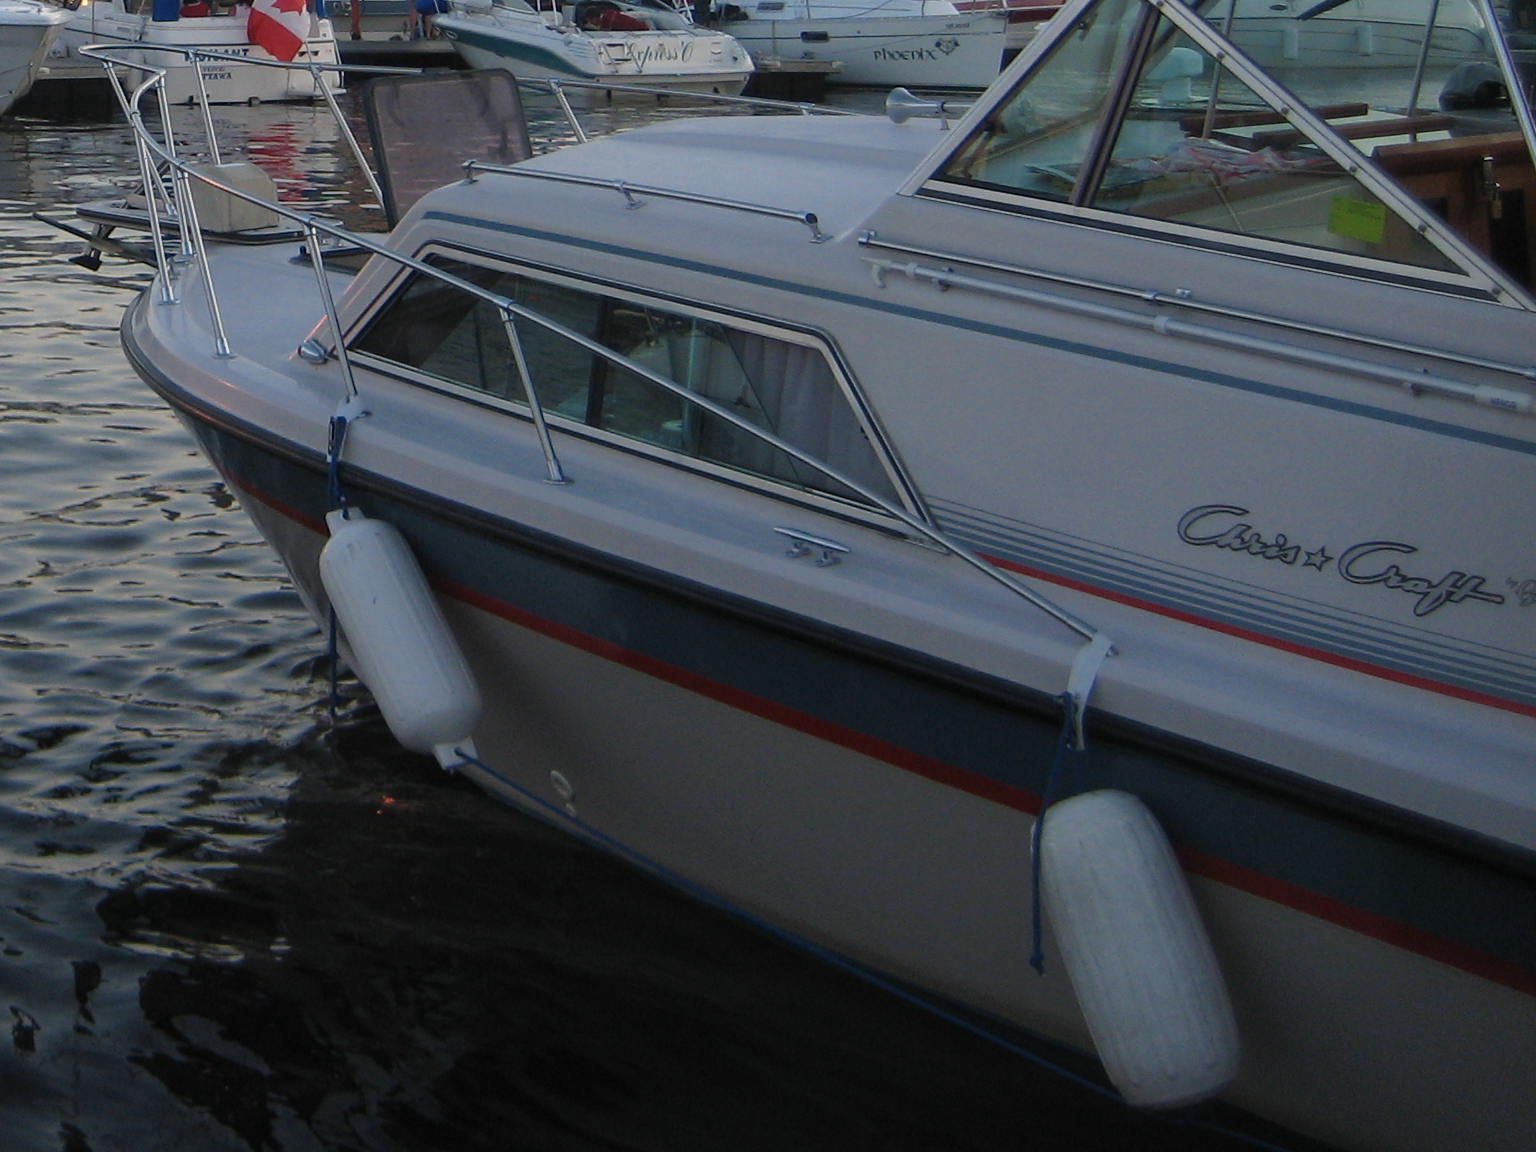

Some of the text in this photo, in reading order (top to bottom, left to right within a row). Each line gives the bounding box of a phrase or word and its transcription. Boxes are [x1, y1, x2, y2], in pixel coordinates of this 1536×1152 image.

[201, 72, 232, 80] TTAWA
[1177, 504, 1302, 565] Chris
[1337, 541, 1505, 617] Craft
